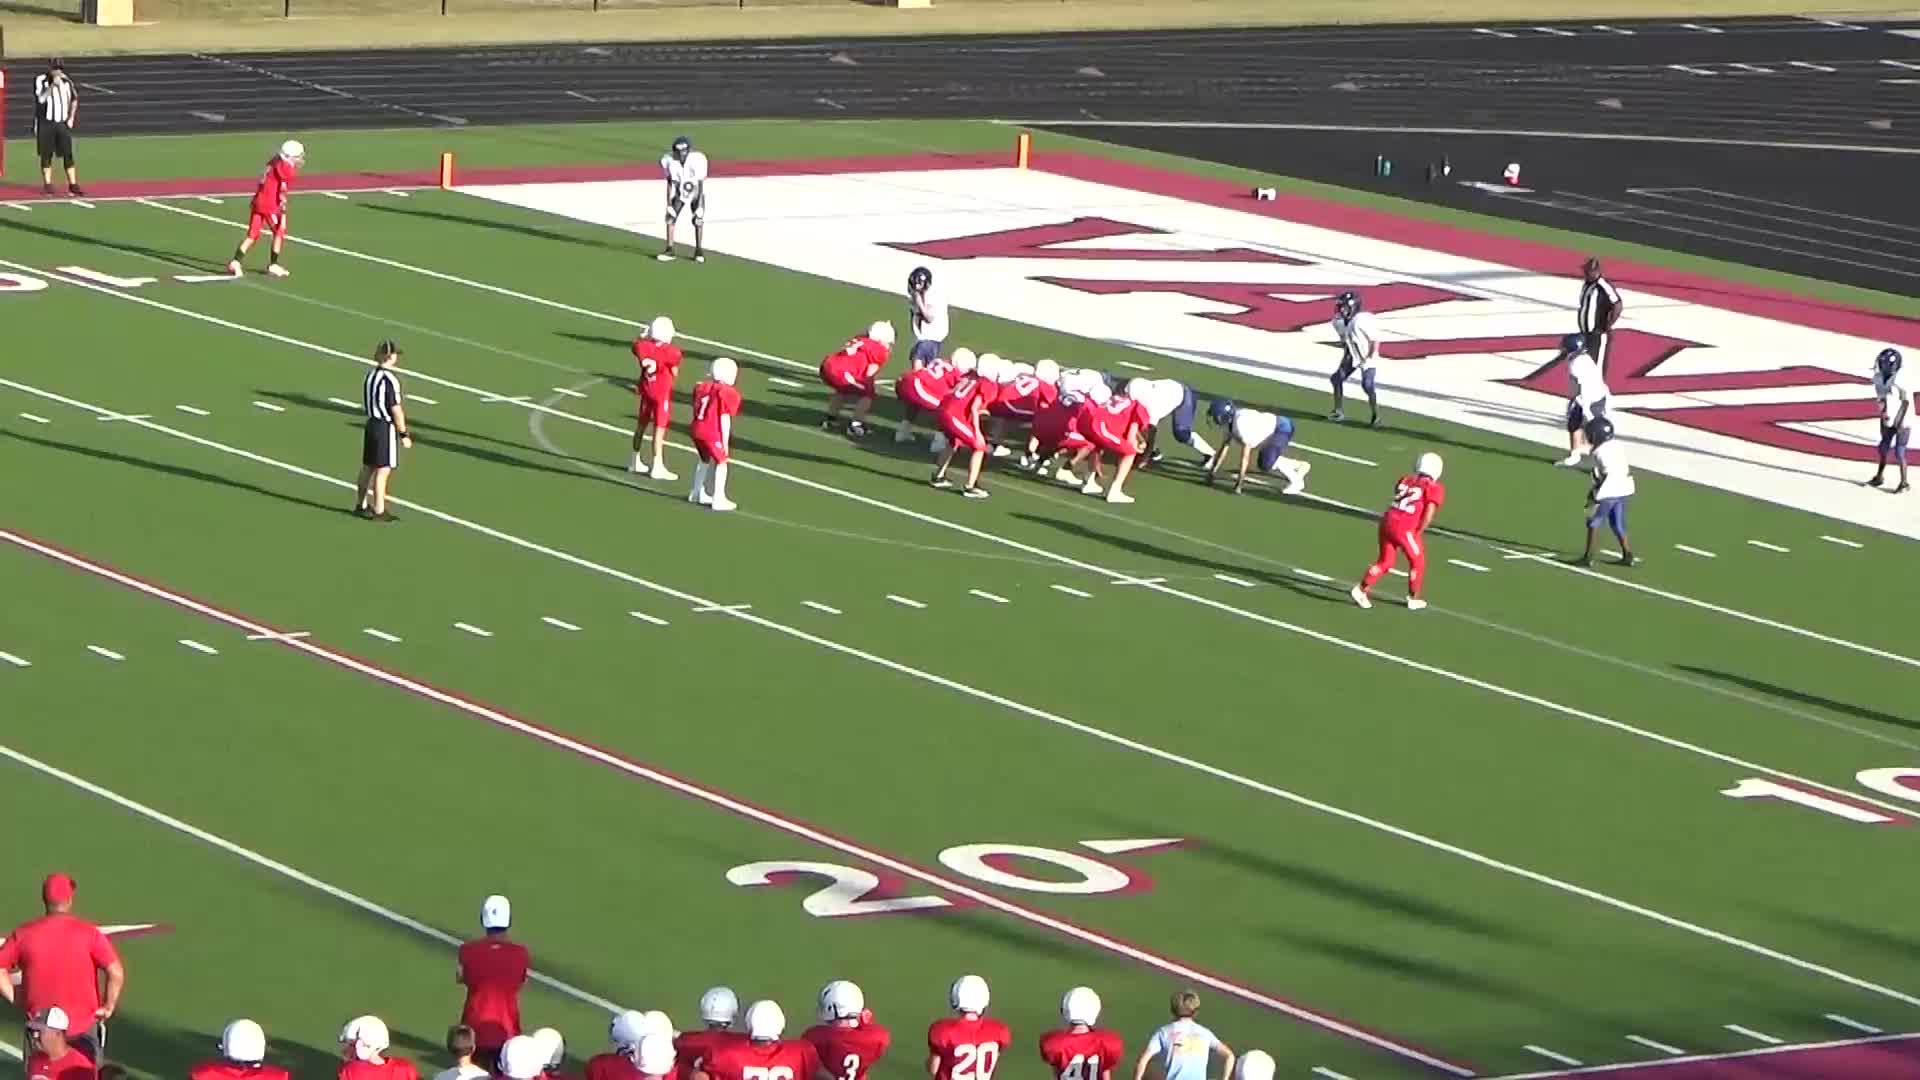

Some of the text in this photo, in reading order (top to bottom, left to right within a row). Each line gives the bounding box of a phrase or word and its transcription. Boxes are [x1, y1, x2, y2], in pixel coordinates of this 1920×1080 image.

[726, 842, 1138, 918] 20
[841, 1053, 859, 1080] 3
[951, 1041, 999, 1080] 20
[1061, 1054, 1099, 1080] 41
